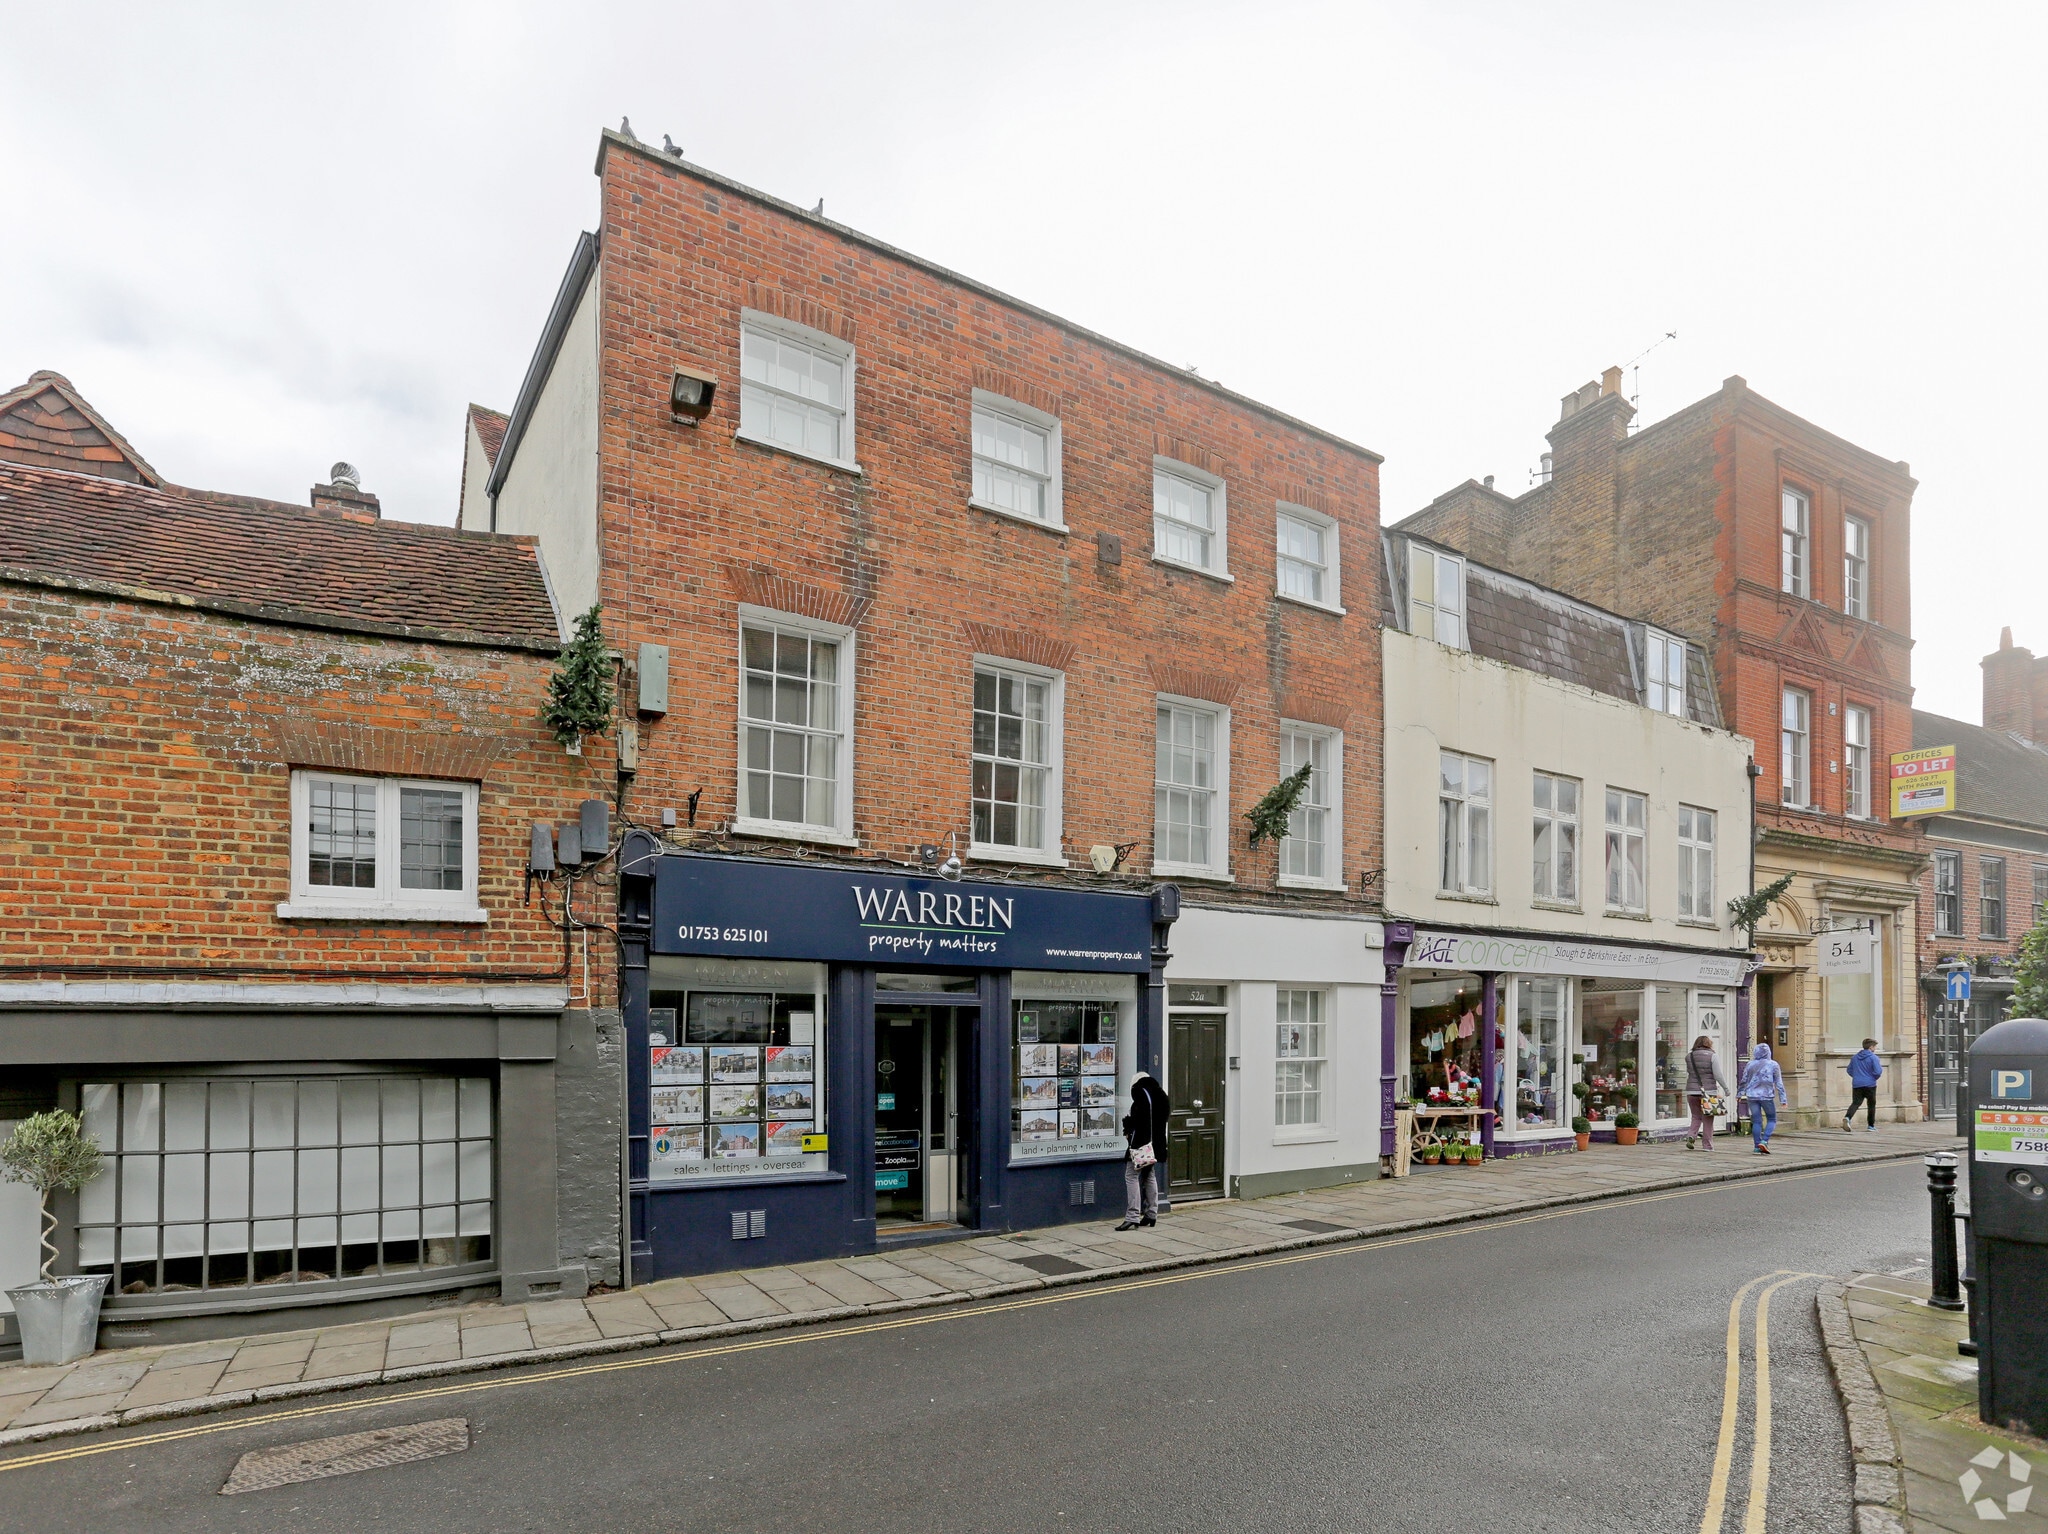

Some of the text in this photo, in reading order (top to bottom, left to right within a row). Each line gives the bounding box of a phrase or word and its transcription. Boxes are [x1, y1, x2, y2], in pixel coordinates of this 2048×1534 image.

[1902, 749, 1942, 761] OFFICES
[1895, 758, 1950, 776] TO LET
[1916, 779, 1948, 788] PARKING
[851, 885, 1014, 930] WARREN
[678, 925, 769, 943] 01753 625101
[869, 931, 997, 956] property matters
[1831, 941, 1855, 957] 54
[1045, 948, 1143, 961] www.warrenproperty.co.uk
[1457, 940, 1550, 969] concern
[1555, 946, 1579, 962] Slough
[1580, 949, 1586, 959] &
[1586, 949, 1617, 962] Berkshire
[1617, 953, 1632, 962] East
[1638, 955, 1645, 964] in
[1645, 955, 1659, 965] Eton
[1189, 990, 1205, 1001] 52a
[1997, 1070, 2025, 1097] P
[1021, 1145, 1038, 1155] land
[1046, 1143, 1078, 1154] planning
[1085, 1142, 1102, 1150] new
[673, 1164, 700, 1176] sales
[712, 1162, 750, 1174] lettings
